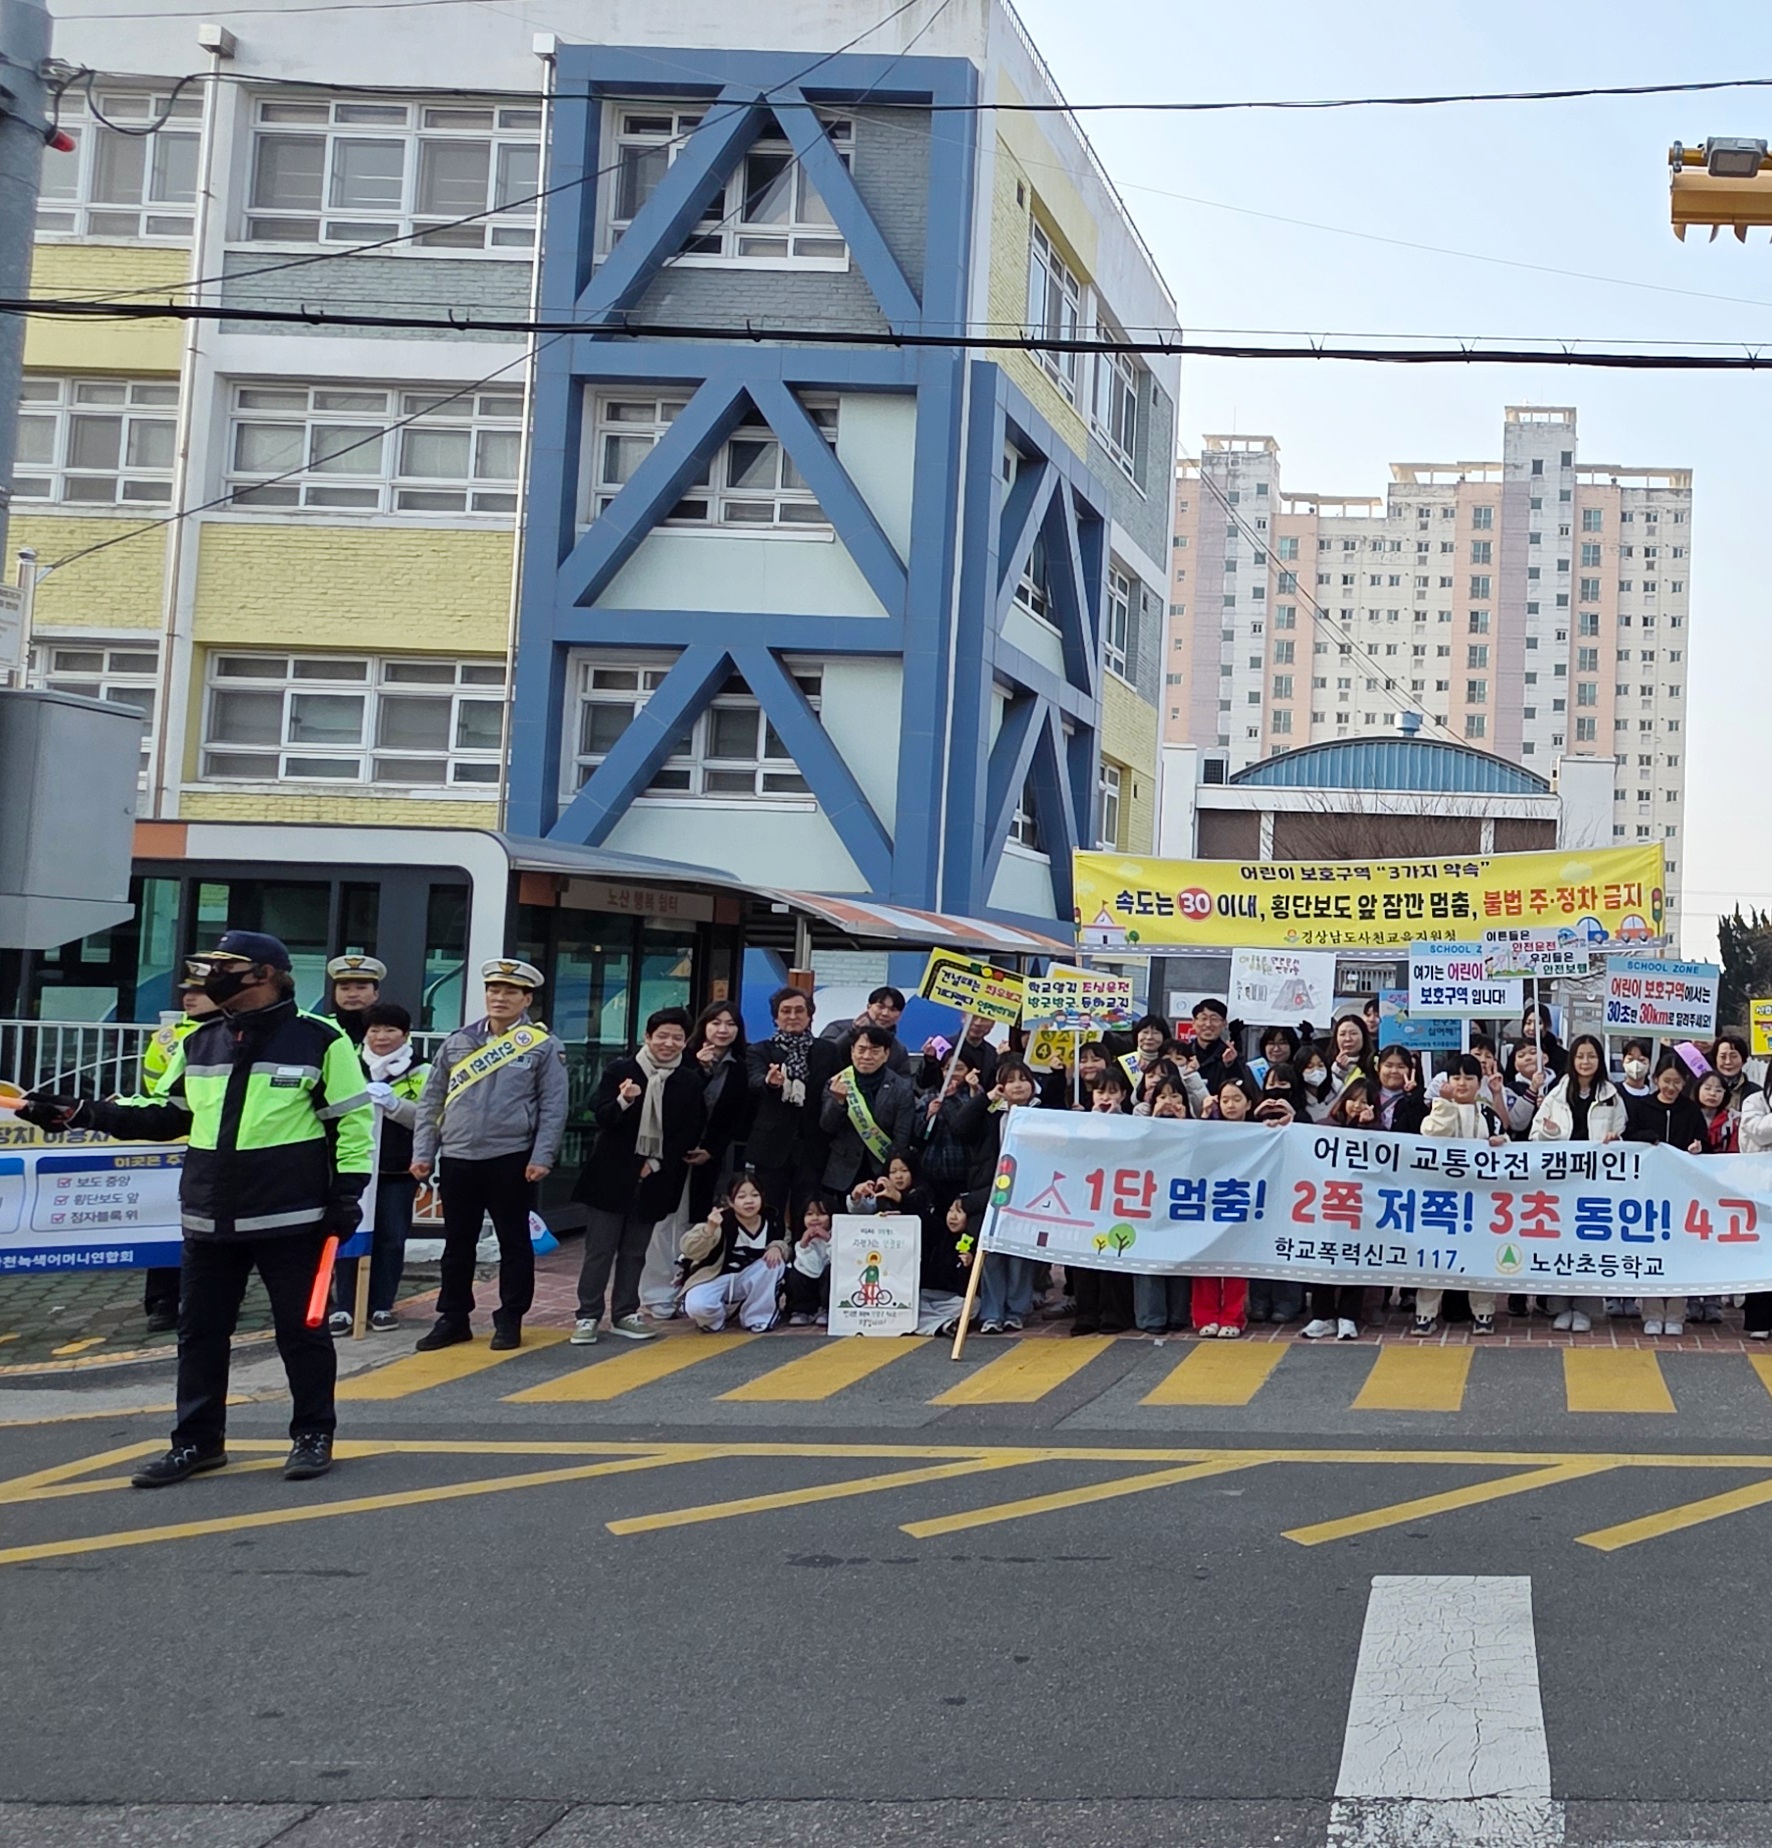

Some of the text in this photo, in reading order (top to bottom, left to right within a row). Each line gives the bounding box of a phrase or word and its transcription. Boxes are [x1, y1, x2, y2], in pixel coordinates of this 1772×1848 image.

[1240, 866, 1294, 881] 어린이
[1300, 866, 1371, 881] 보호구역
[608, 888, 630, 908] 노산
[1116, 890, 1174, 916] 속도는
[1180, 892, 1210, 914] 30
[1217, 894, 1265, 922] 이내,
[1271, 895, 1352, 920] 횡단보도
[1358, 894, 1377, 921] 앞
[1384, 893, 1423, 919] 잠깐
[1430, 891, 1477, 921] 멈춤,
[1484, 889, 1522, 917] 불법
[1603, 883, 1643, 908] 금지
[1430, 945, 1471, 954] SCHOOL
[1414, 963, 1483, 981] 여기는 어린이
[1627, 961, 1700, 974] SCHOOL ZONE
[1420, 986, 1468, 1005] 보호구역
[1472, 988, 1505, 1005] 입니다!
[1611, 977, 1641, 998] 어린이
[114, 1155, 161, 1168] 이곳은
[1314, 1136, 1641, 1182] 어린이 교통안전 캠페인!
[76, 1176, 131, 1188] 보도 중앙
[73, 1192, 139, 1206] 횡단보도 앞
[1085, 1168, 1158, 1219] 1단
[1169, 1178, 1268, 1223] 멈춤!
[1291, 1180, 1363, 1231] 2쪽
[1378, 1187, 1474, 1234] 저쪽!
[1490, 1190, 1562, 1239] 3초
[1575, 1197, 1671, 1242] 동안!
[1684, 1199, 1760, 1243] 4고
[71, 1209, 139, 1223] 점자블록 위
[0, 1250, 134, 1269] 천녹색어머니연합회
[1274, 1235, 1407, 1268] 학교폭력신고
[1530, 1252, 1665, 1279] 노산초등학교
